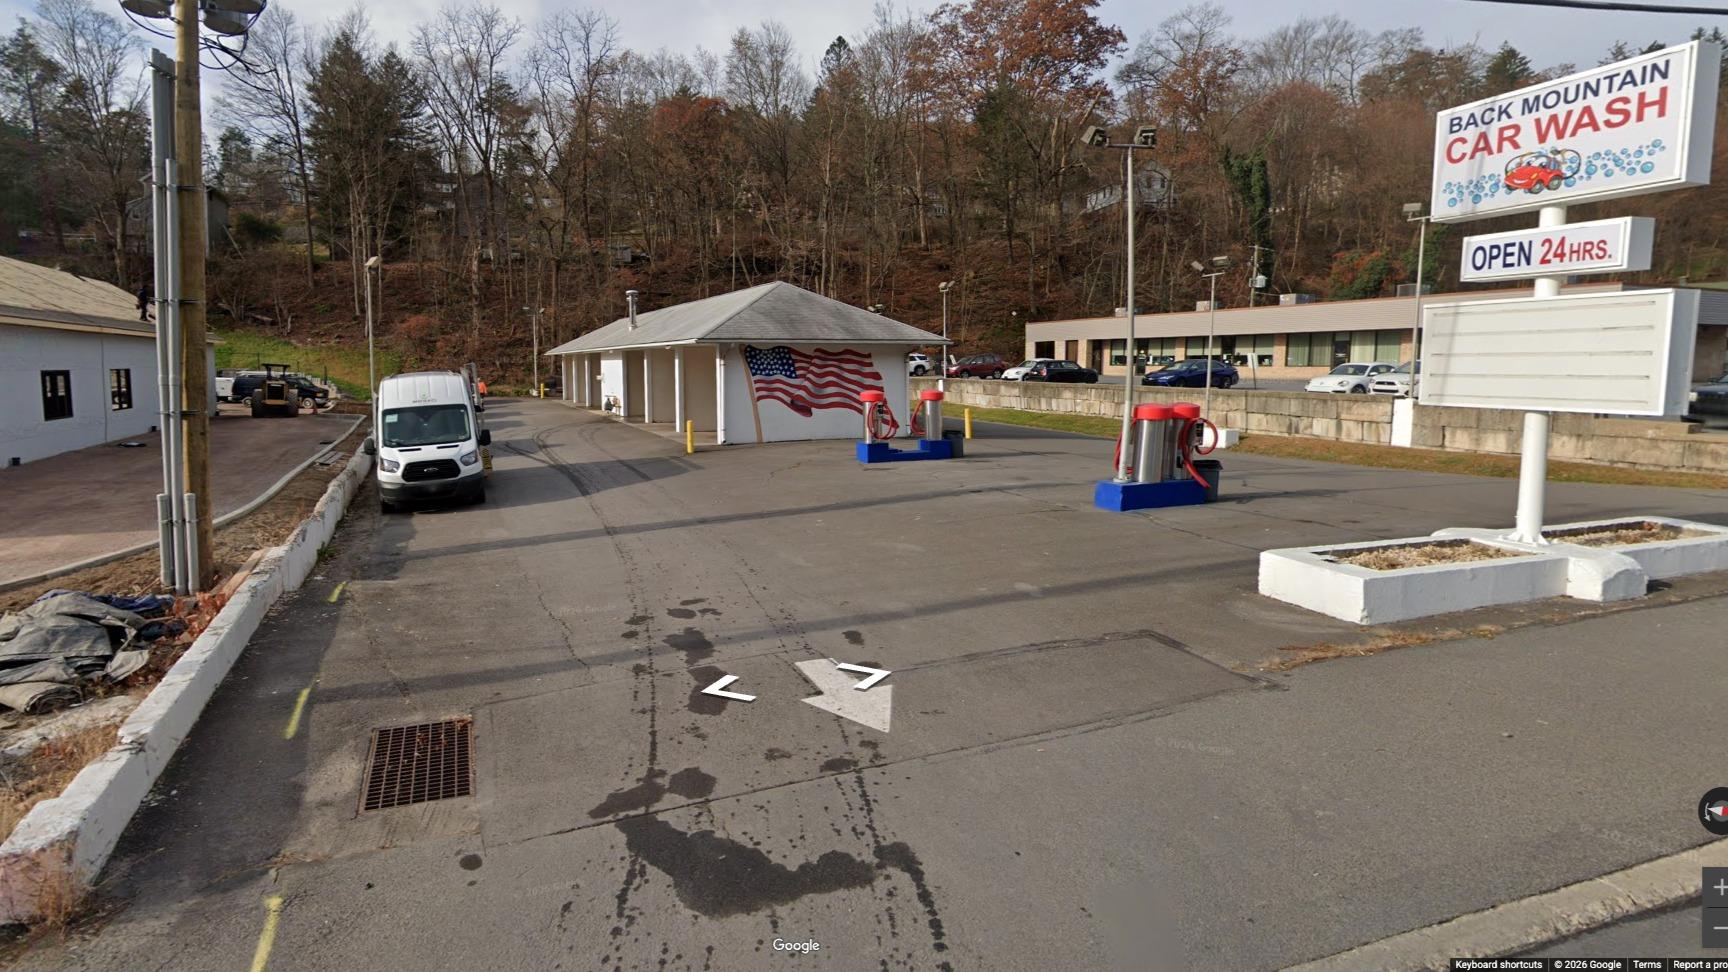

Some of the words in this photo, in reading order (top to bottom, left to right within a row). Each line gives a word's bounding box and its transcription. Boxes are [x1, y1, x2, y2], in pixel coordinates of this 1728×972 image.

[1445, 123, 1521, 164] CAR
[1535, 86, 1668, 144] WASH
[1449, 102, 1513, 134] BACK
[1520, 59, 1671, 115] MOUNTAIN
[1471, 240, 1533, 271] OPEN
